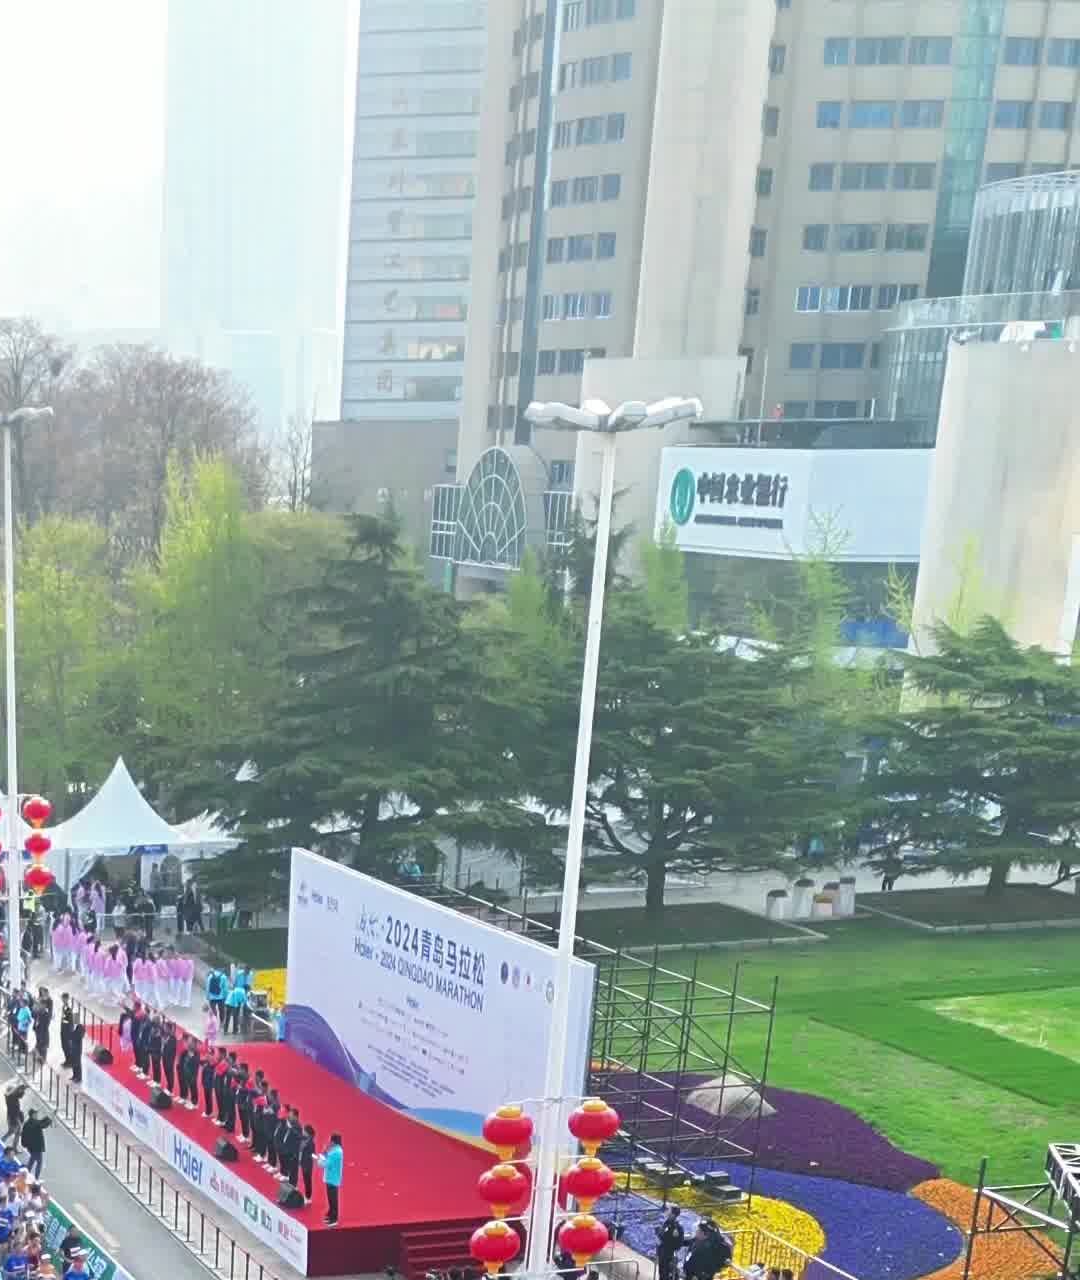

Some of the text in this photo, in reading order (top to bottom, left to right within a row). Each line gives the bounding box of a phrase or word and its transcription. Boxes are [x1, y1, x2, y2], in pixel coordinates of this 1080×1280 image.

[397, 956, 435, 990] QINGDAO
[435, 971, 484, 1013] MARATHON
[172, 1133, 204, 1186] Haier
